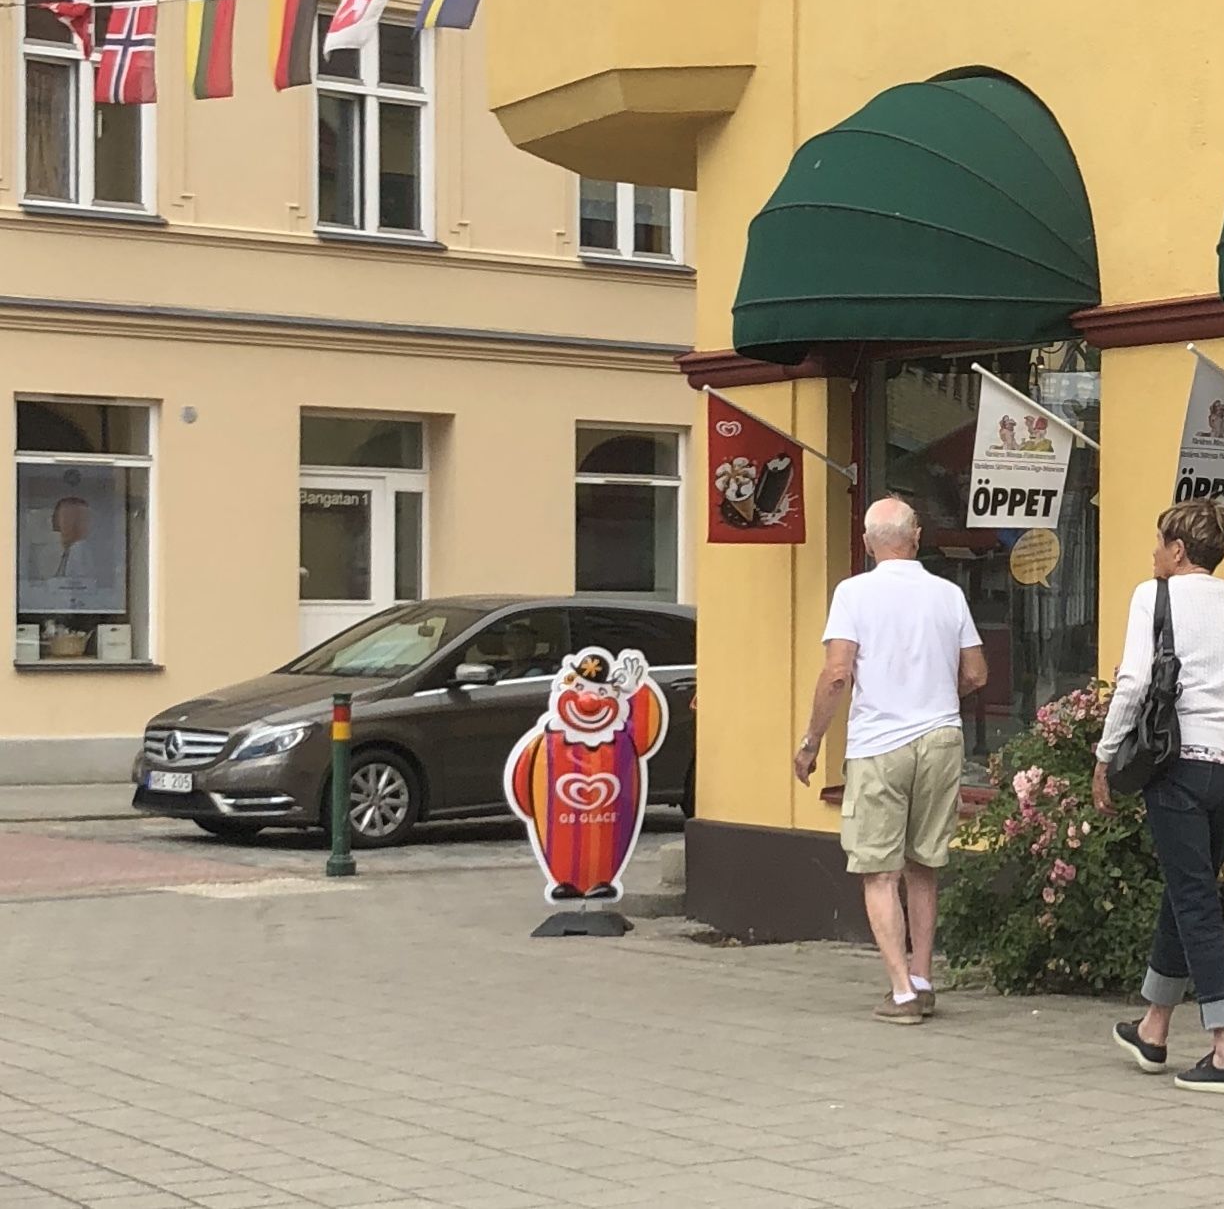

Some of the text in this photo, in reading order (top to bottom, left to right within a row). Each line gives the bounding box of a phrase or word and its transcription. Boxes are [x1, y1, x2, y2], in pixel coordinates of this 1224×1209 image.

[298, 490, 369, 508] Bangatan 1
[972, 478, 1058, 518] ÖPPET
